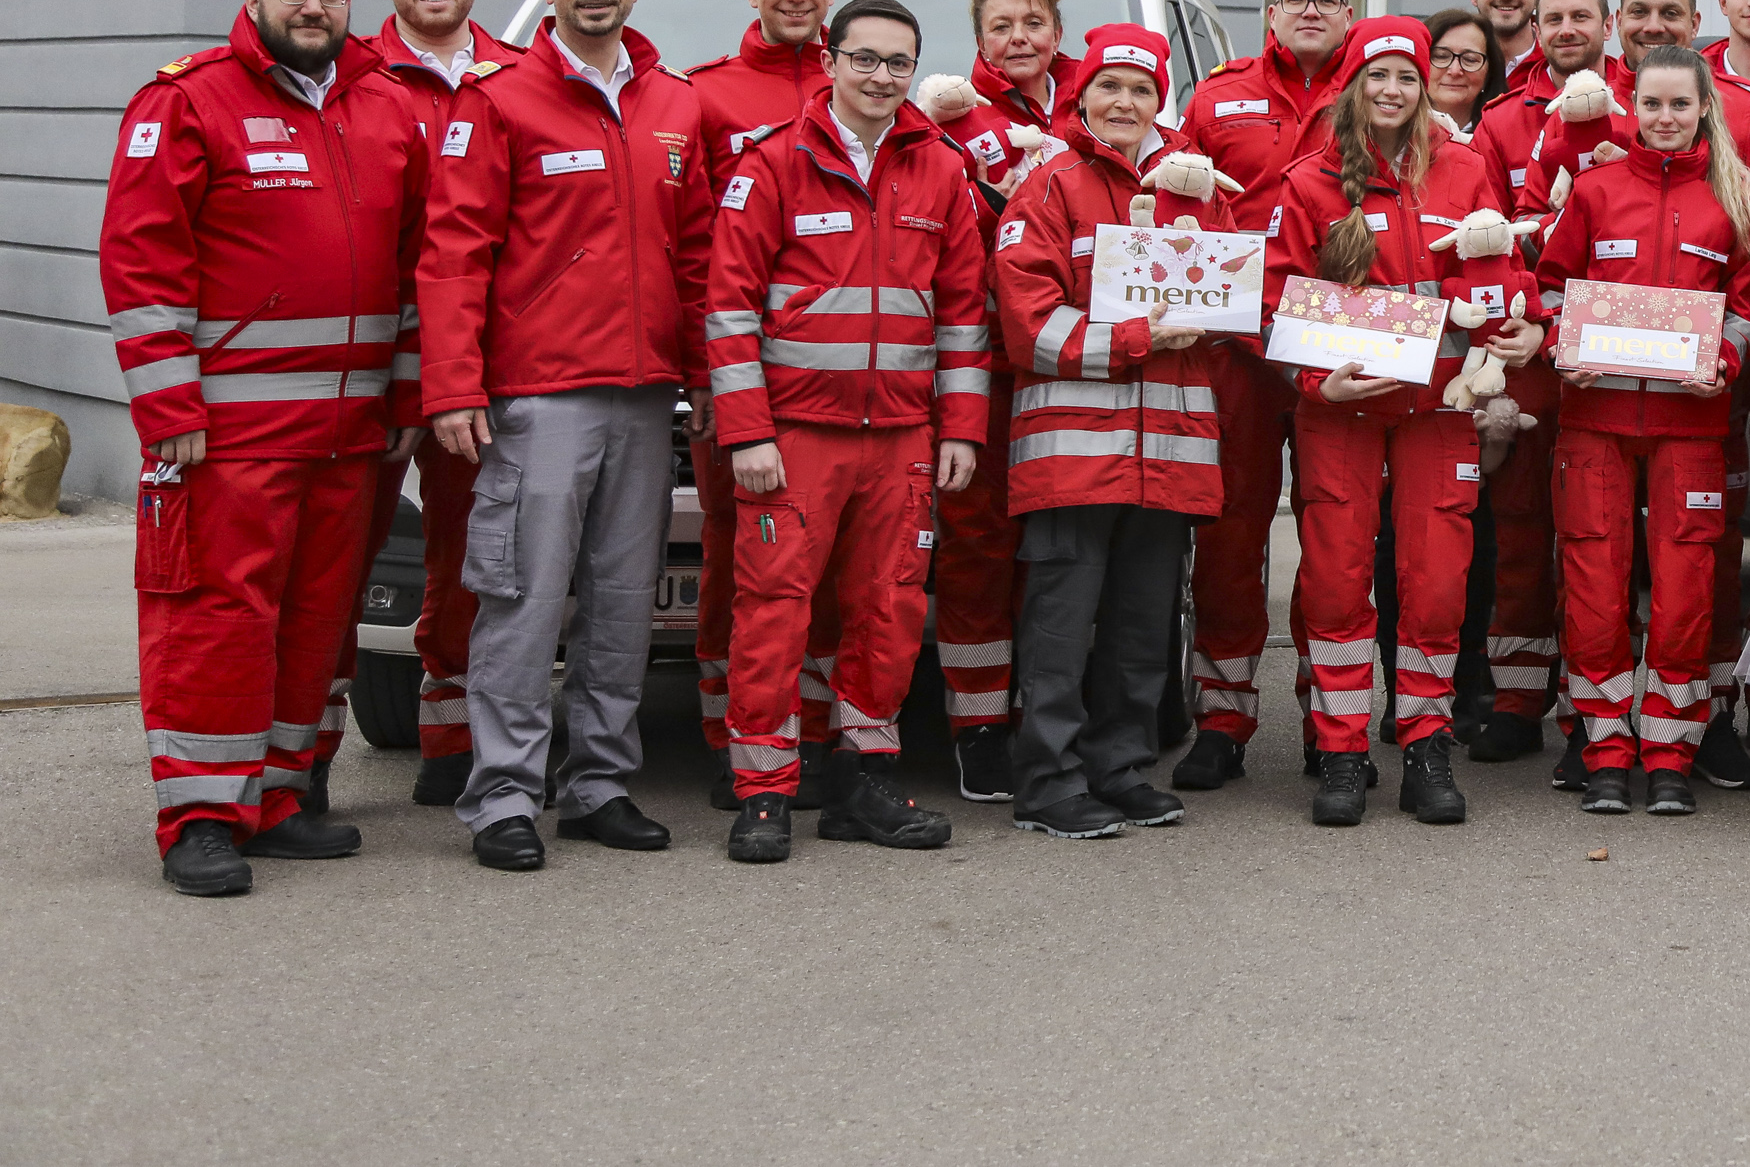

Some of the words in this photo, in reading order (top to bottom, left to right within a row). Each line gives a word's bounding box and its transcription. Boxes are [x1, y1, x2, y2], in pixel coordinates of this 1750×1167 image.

[253, 178, 287, 189] MÜLLER
[289, 178, 313, 188] Jürgen
[1125, 284, 1230, 308] merci
[1300, 330, 1404, 359] merci
[1588, 334, 1688, 359] merci
